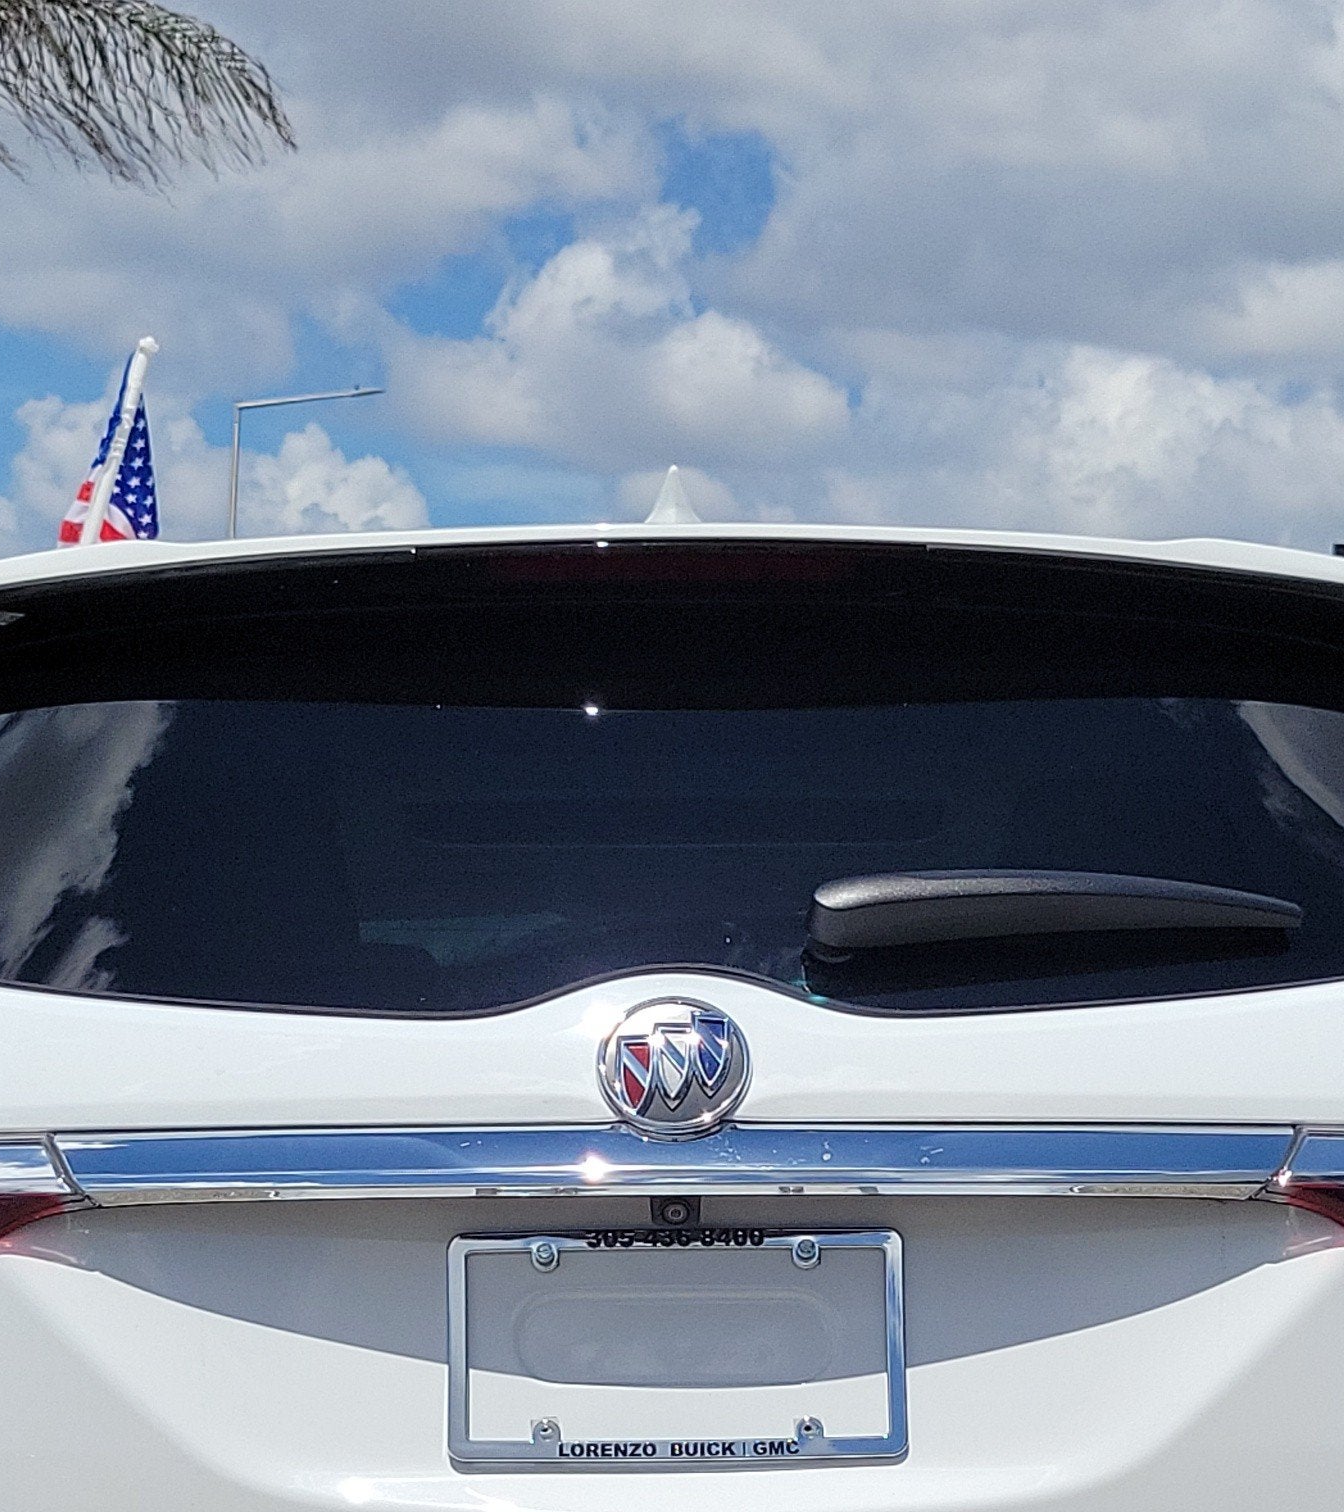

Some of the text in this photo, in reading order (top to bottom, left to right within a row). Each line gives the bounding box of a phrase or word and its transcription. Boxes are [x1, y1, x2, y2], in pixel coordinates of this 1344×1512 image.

[558, 1439, 801, 1458] LORENZO BUICK GMC
